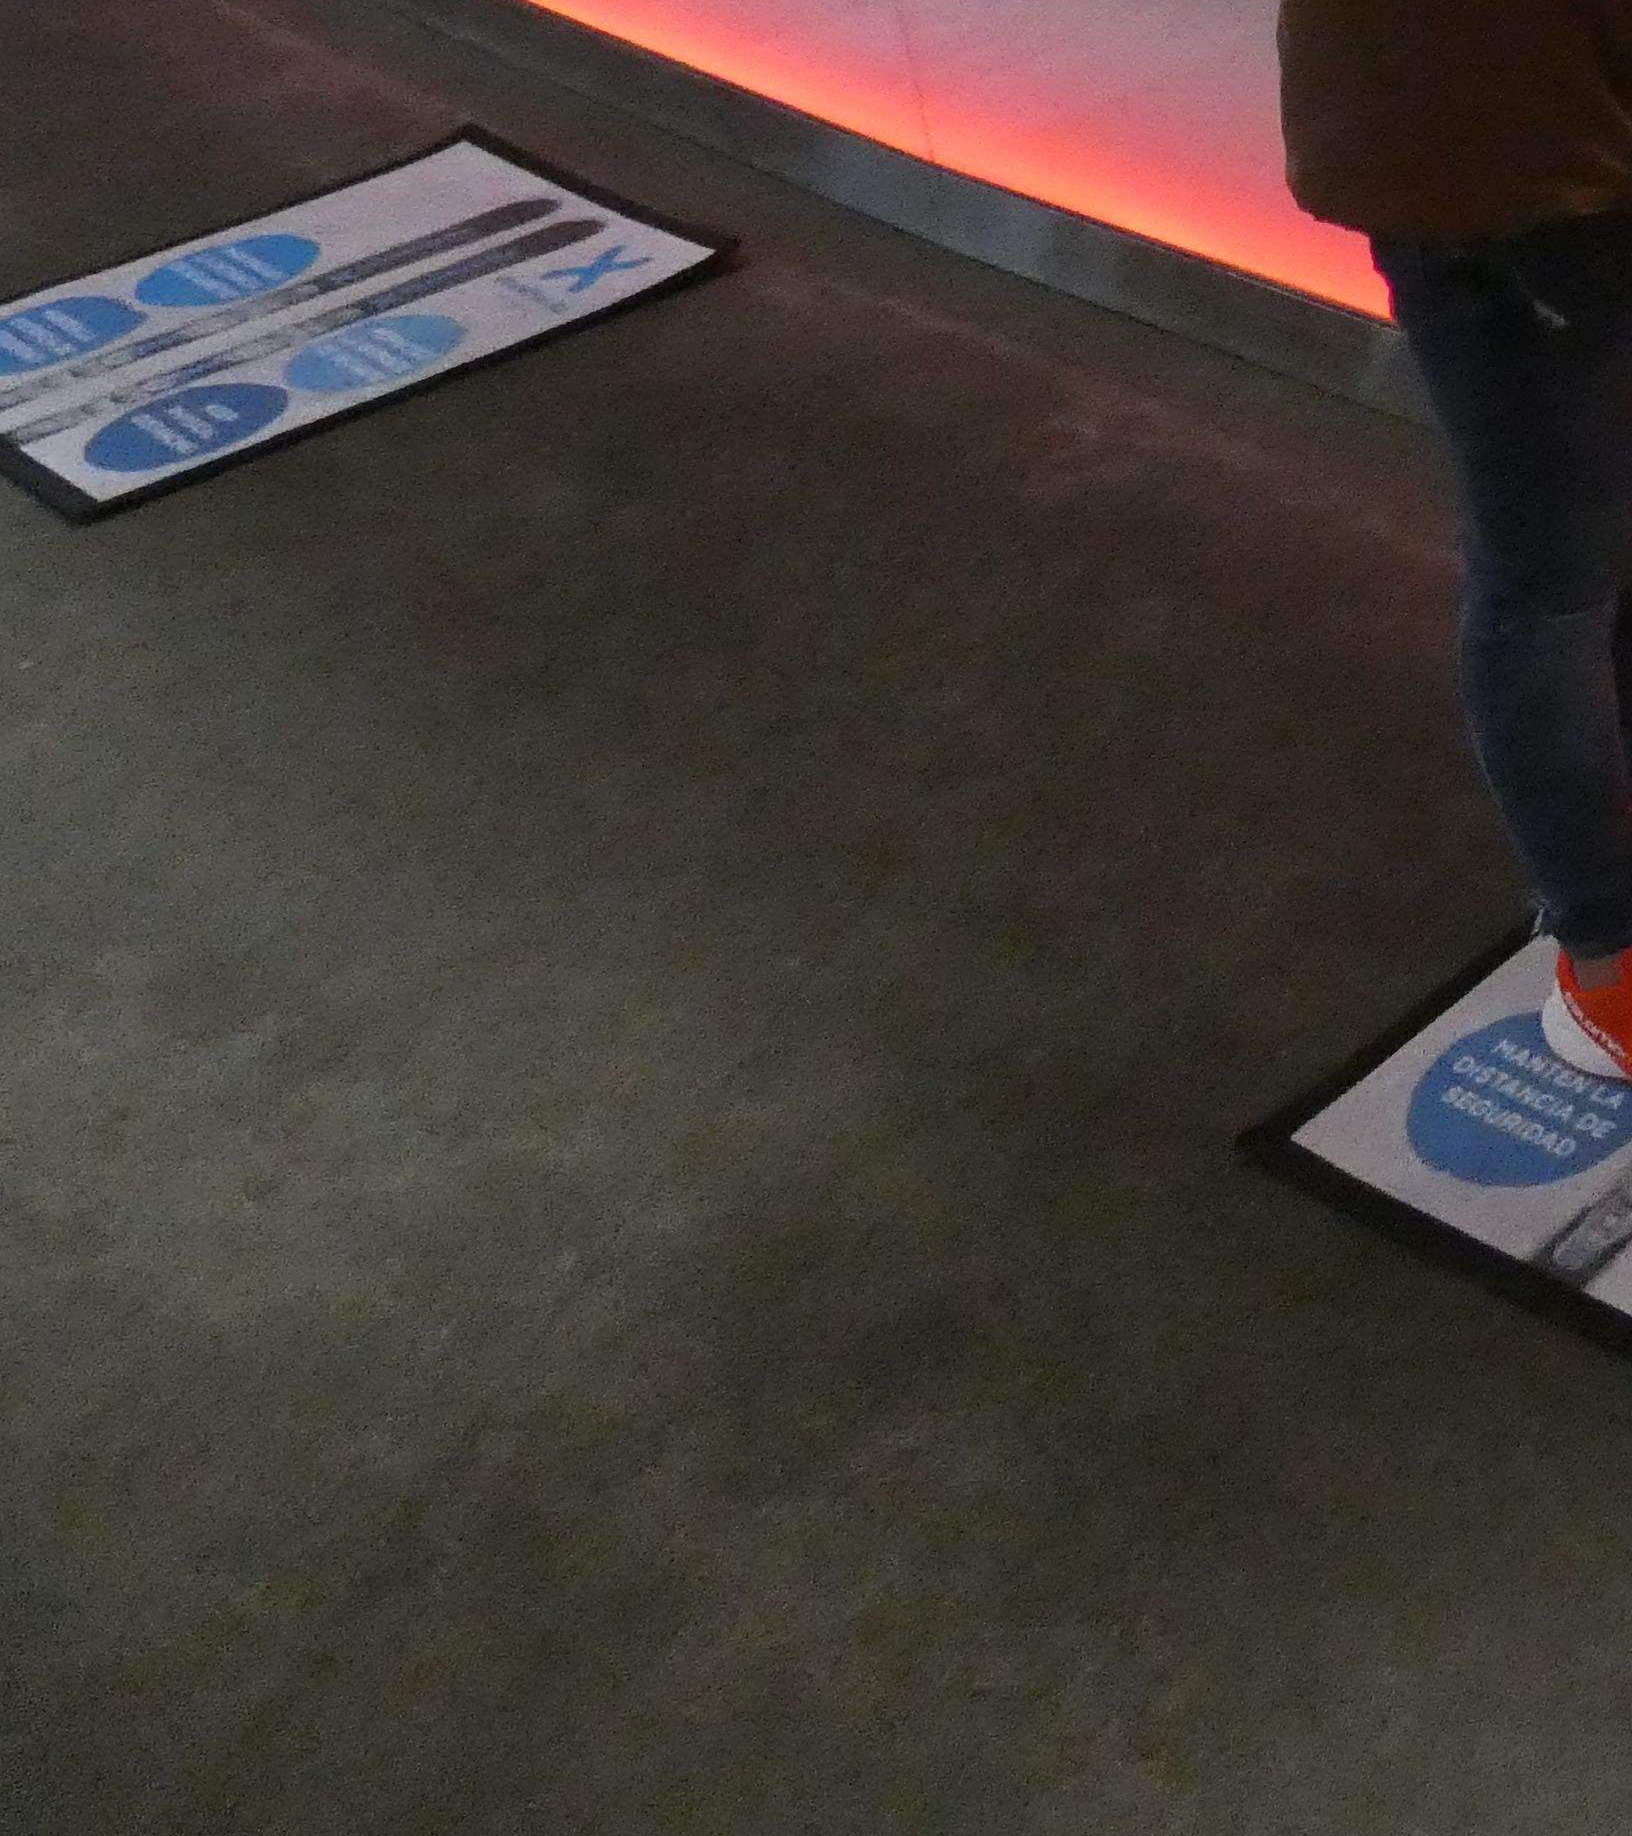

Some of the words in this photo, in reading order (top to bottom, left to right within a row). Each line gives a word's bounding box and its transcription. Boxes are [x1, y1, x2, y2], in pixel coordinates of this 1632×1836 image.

[1441, 1084, 1577, 1157] SEGURIDAD
[1452, 1055, 1575, 1122] DISTANCIA
[1575, 1112, 1617, 1140] DE
[1590, 1086, 1625, 1111] LA
